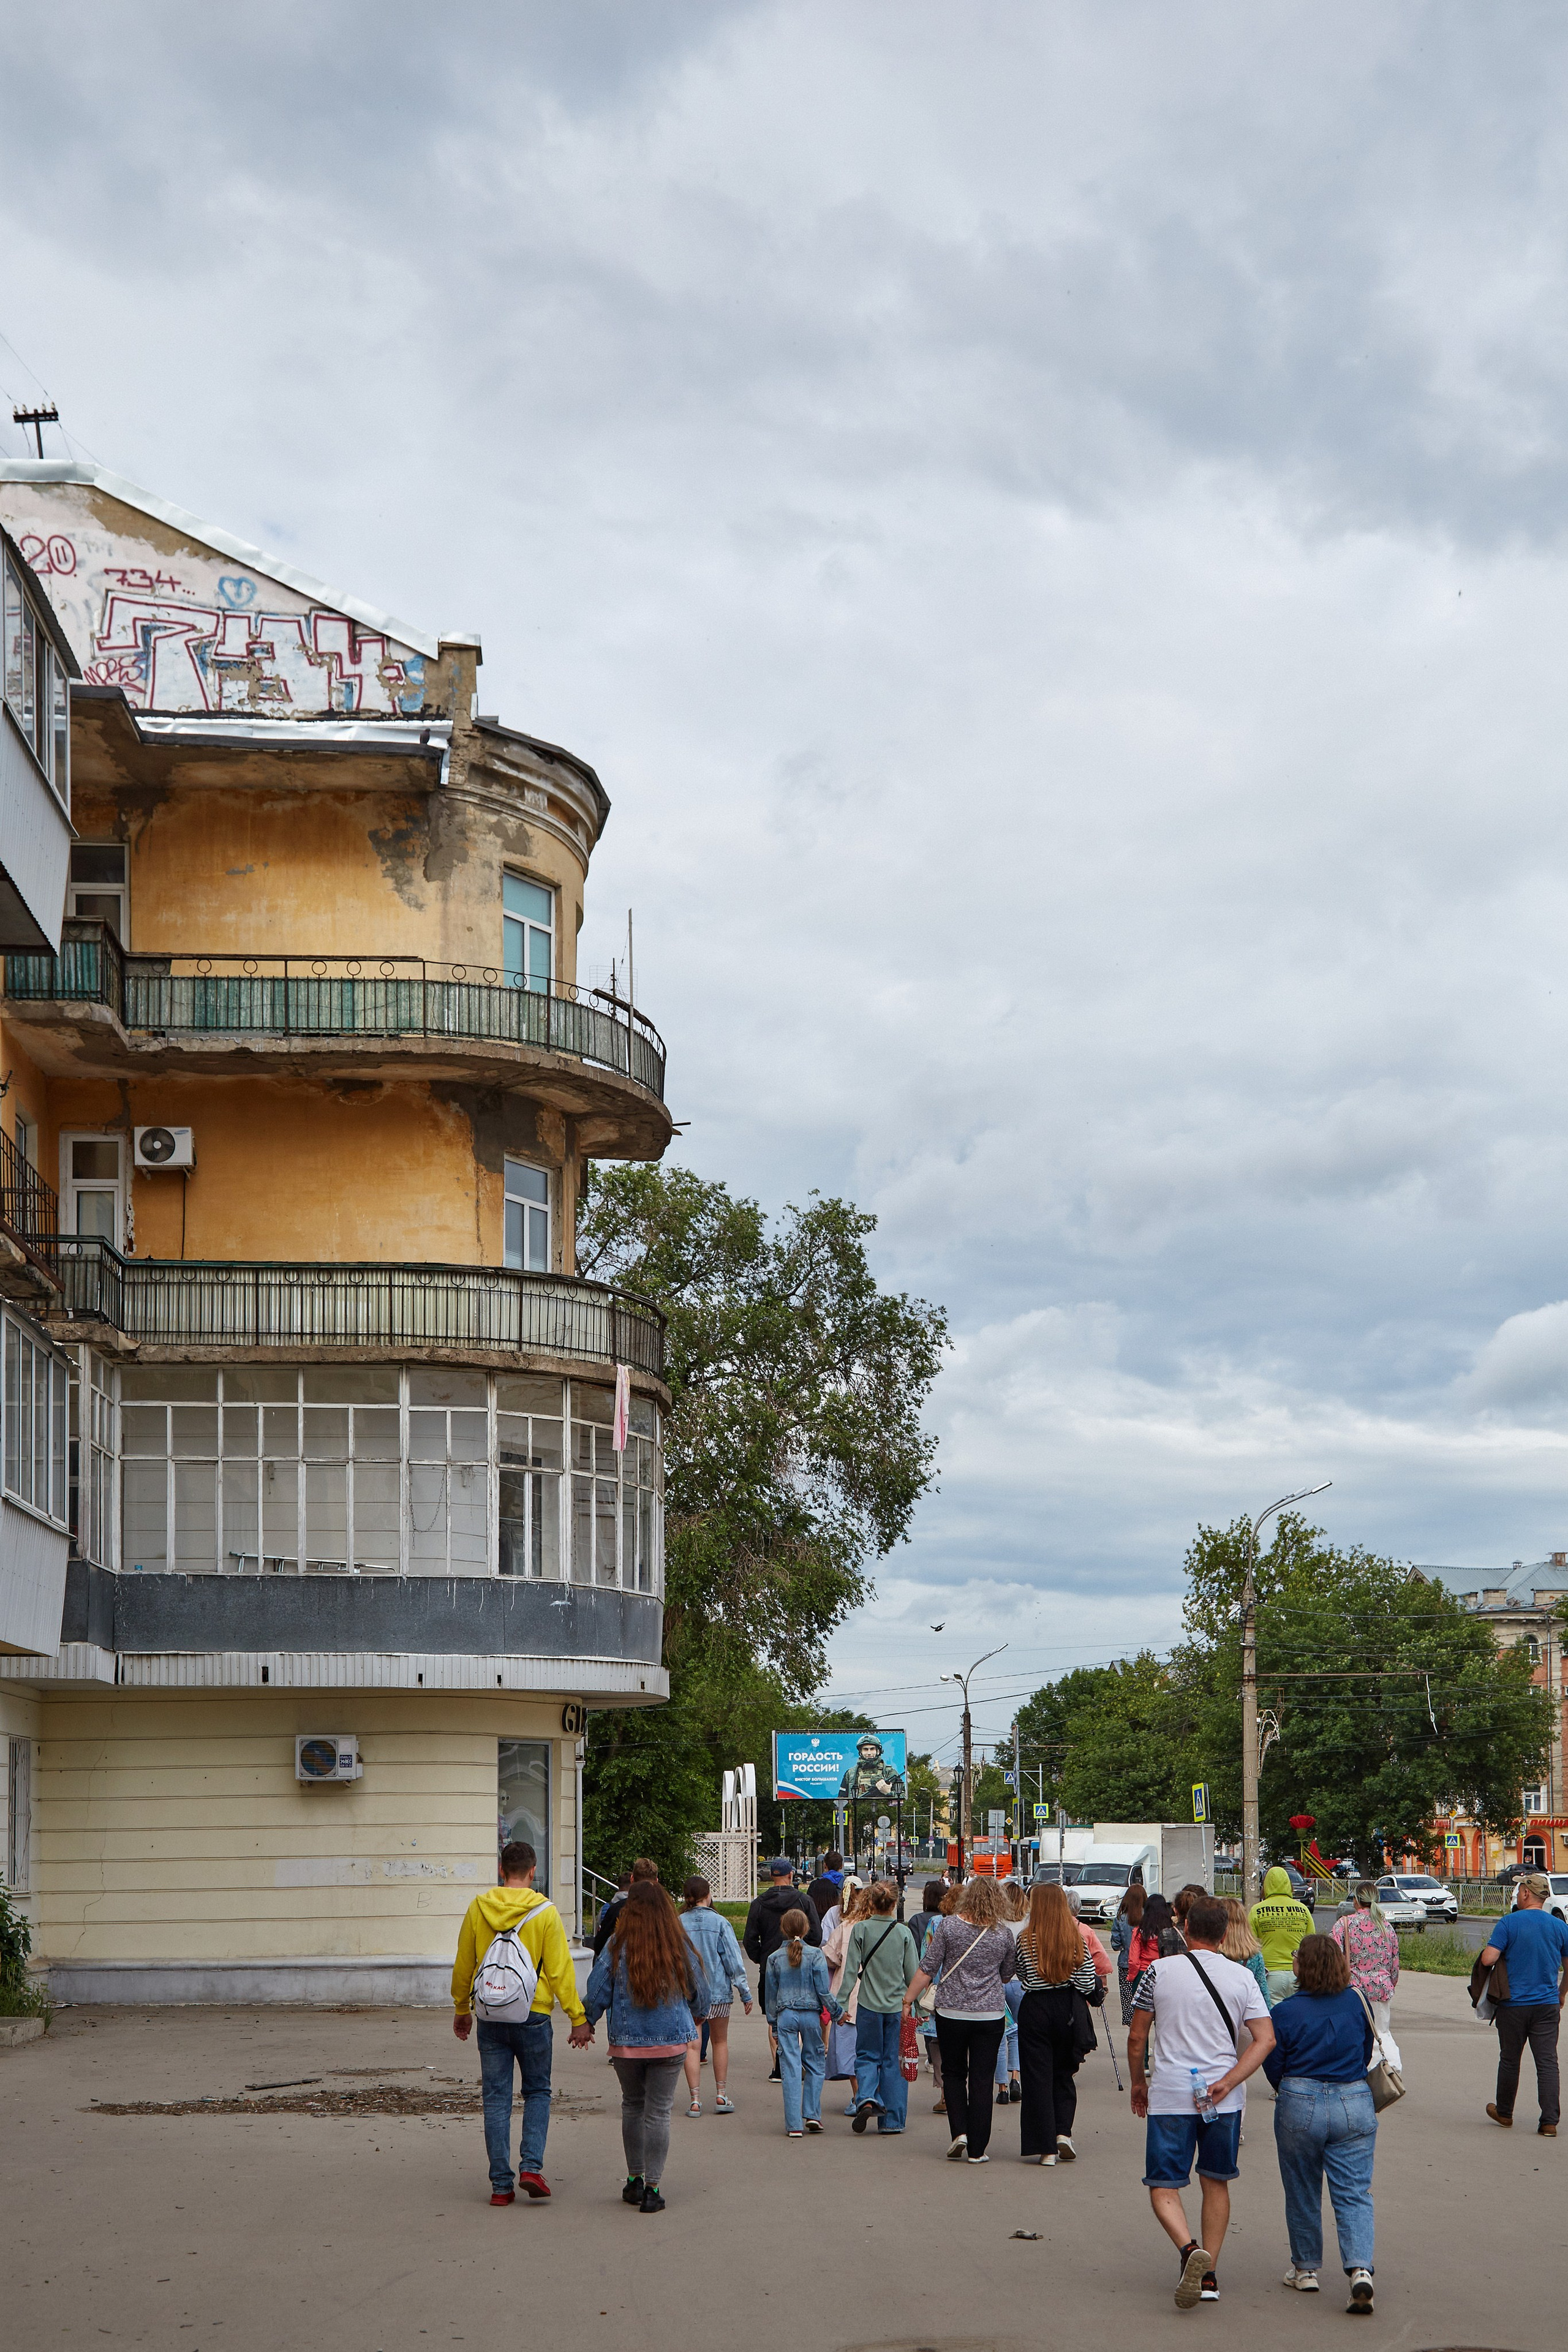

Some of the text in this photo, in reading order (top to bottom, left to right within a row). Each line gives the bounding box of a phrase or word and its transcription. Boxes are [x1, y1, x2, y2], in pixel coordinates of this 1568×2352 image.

[788, 1752, 843, 1762] ГОРДОСТЬ
[792, 1763, 840, 1773] РОССИИ!
[1256, 1906, 1284, 1915] STREET
